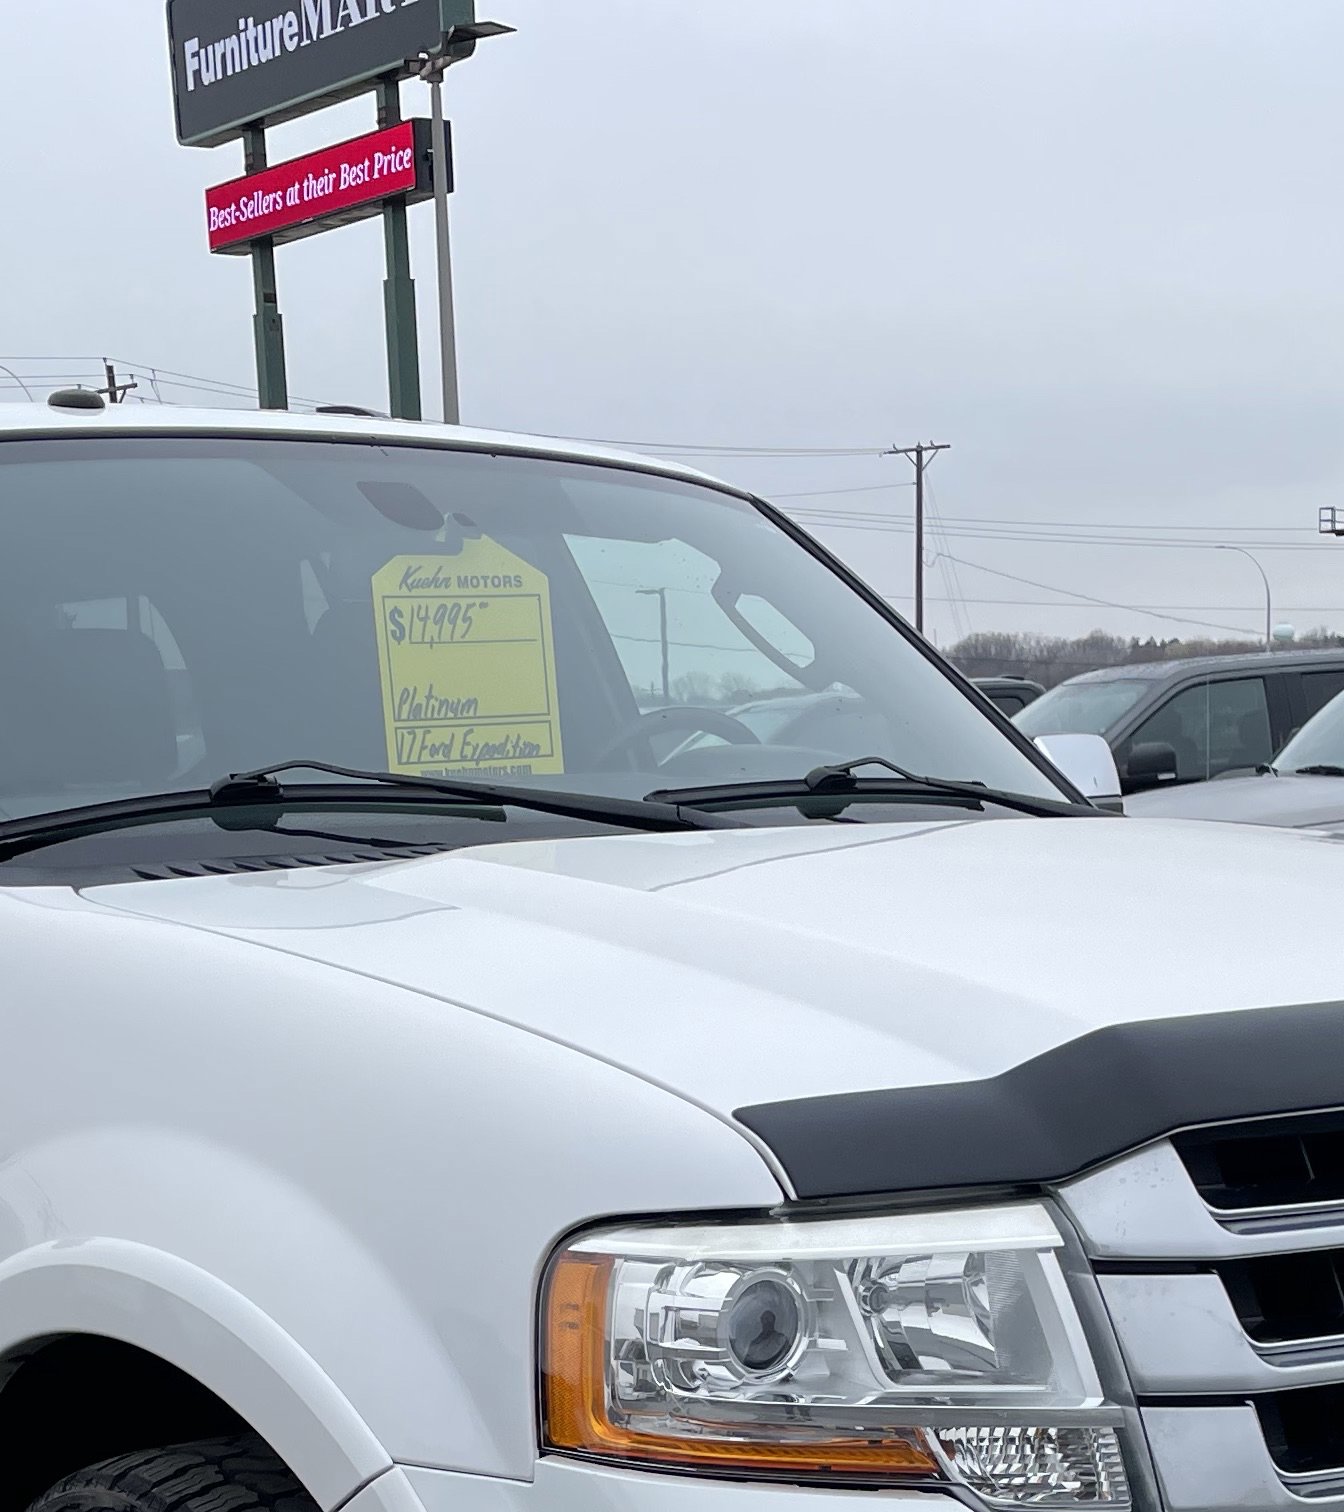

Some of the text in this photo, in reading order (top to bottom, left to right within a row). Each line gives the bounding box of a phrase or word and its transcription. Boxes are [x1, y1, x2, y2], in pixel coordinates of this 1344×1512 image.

[209, 146, 413, 231] Best-Sellers at their Best Price
[399, 566, 523, 592] Kuehn MOTORS
[398, 683, 479, 720] Platinum
